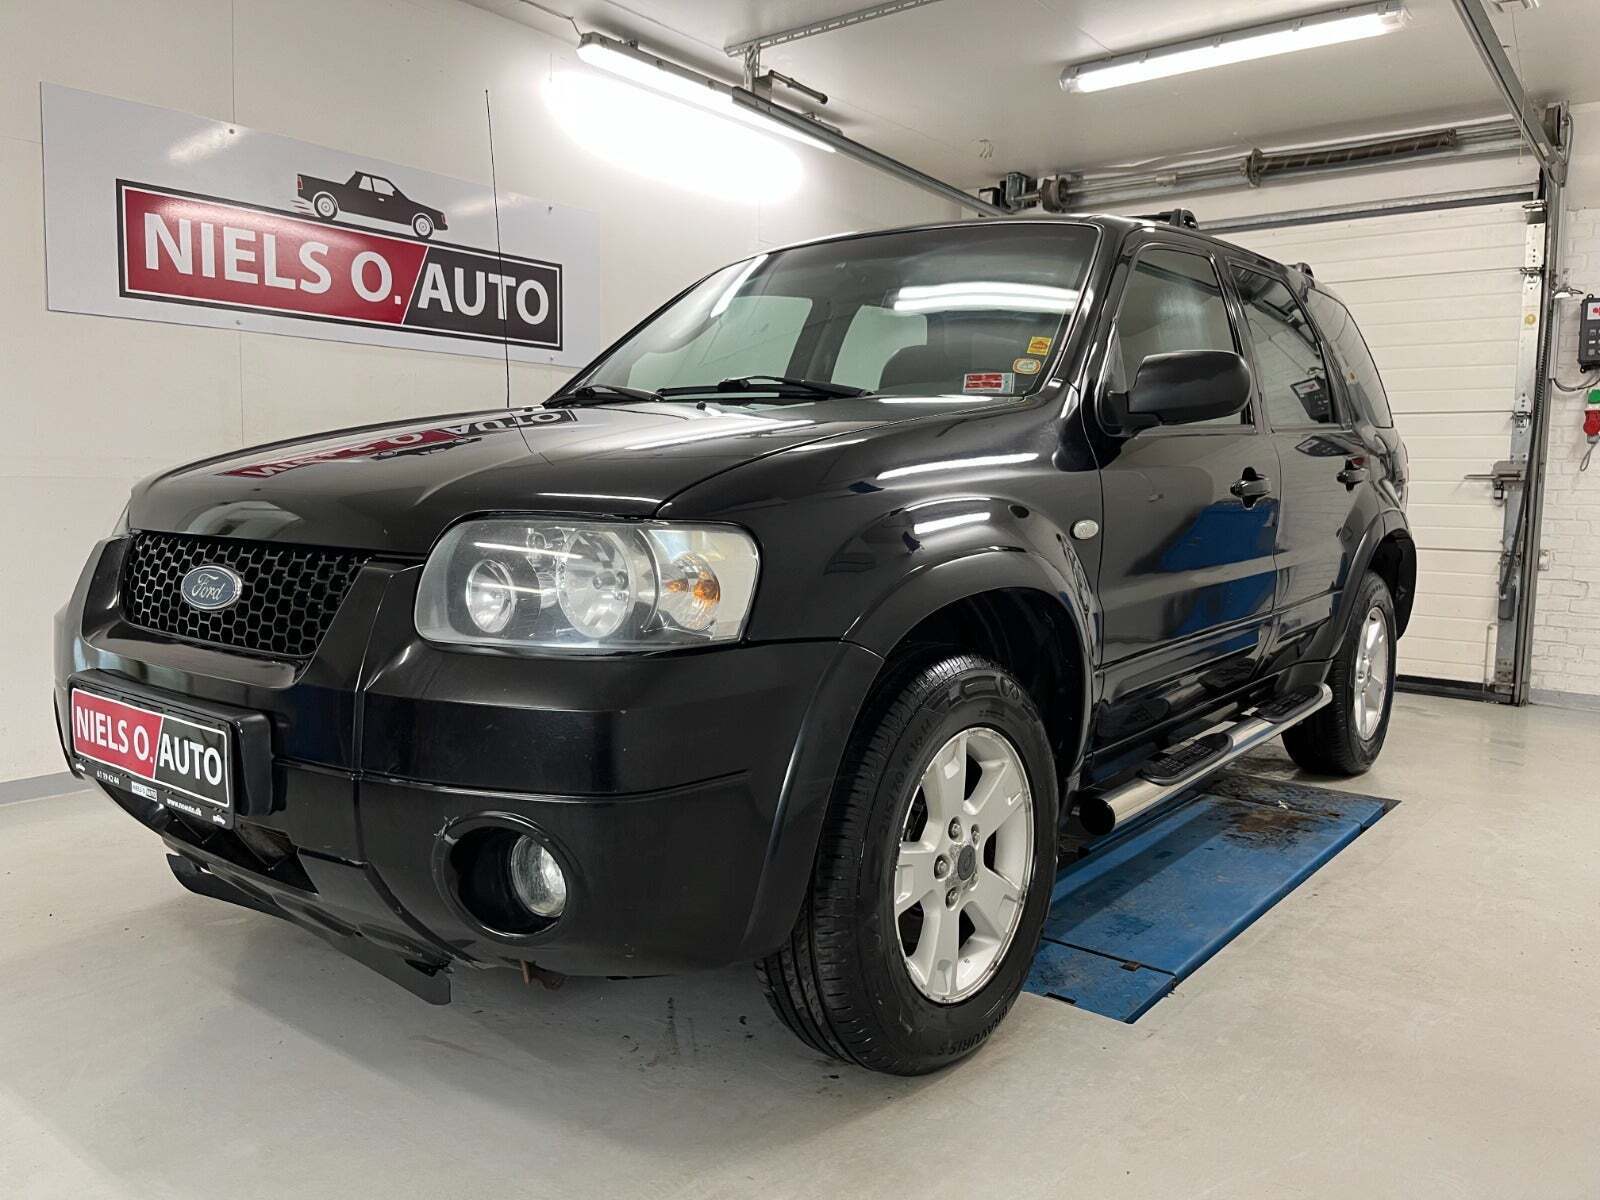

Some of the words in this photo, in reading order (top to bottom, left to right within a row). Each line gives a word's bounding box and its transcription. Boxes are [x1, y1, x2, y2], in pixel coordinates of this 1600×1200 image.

[143, 212, 332, 295] NIELS
[350, 250, 402, 305] O.
[417, 262, 549, 325] AUTO
[191, 573, 226, 601] Ford
[76, 705, 129, 754] NIELS
[133, 725, 153, 763] O.
[159, 733, 222, 786] AUTO
